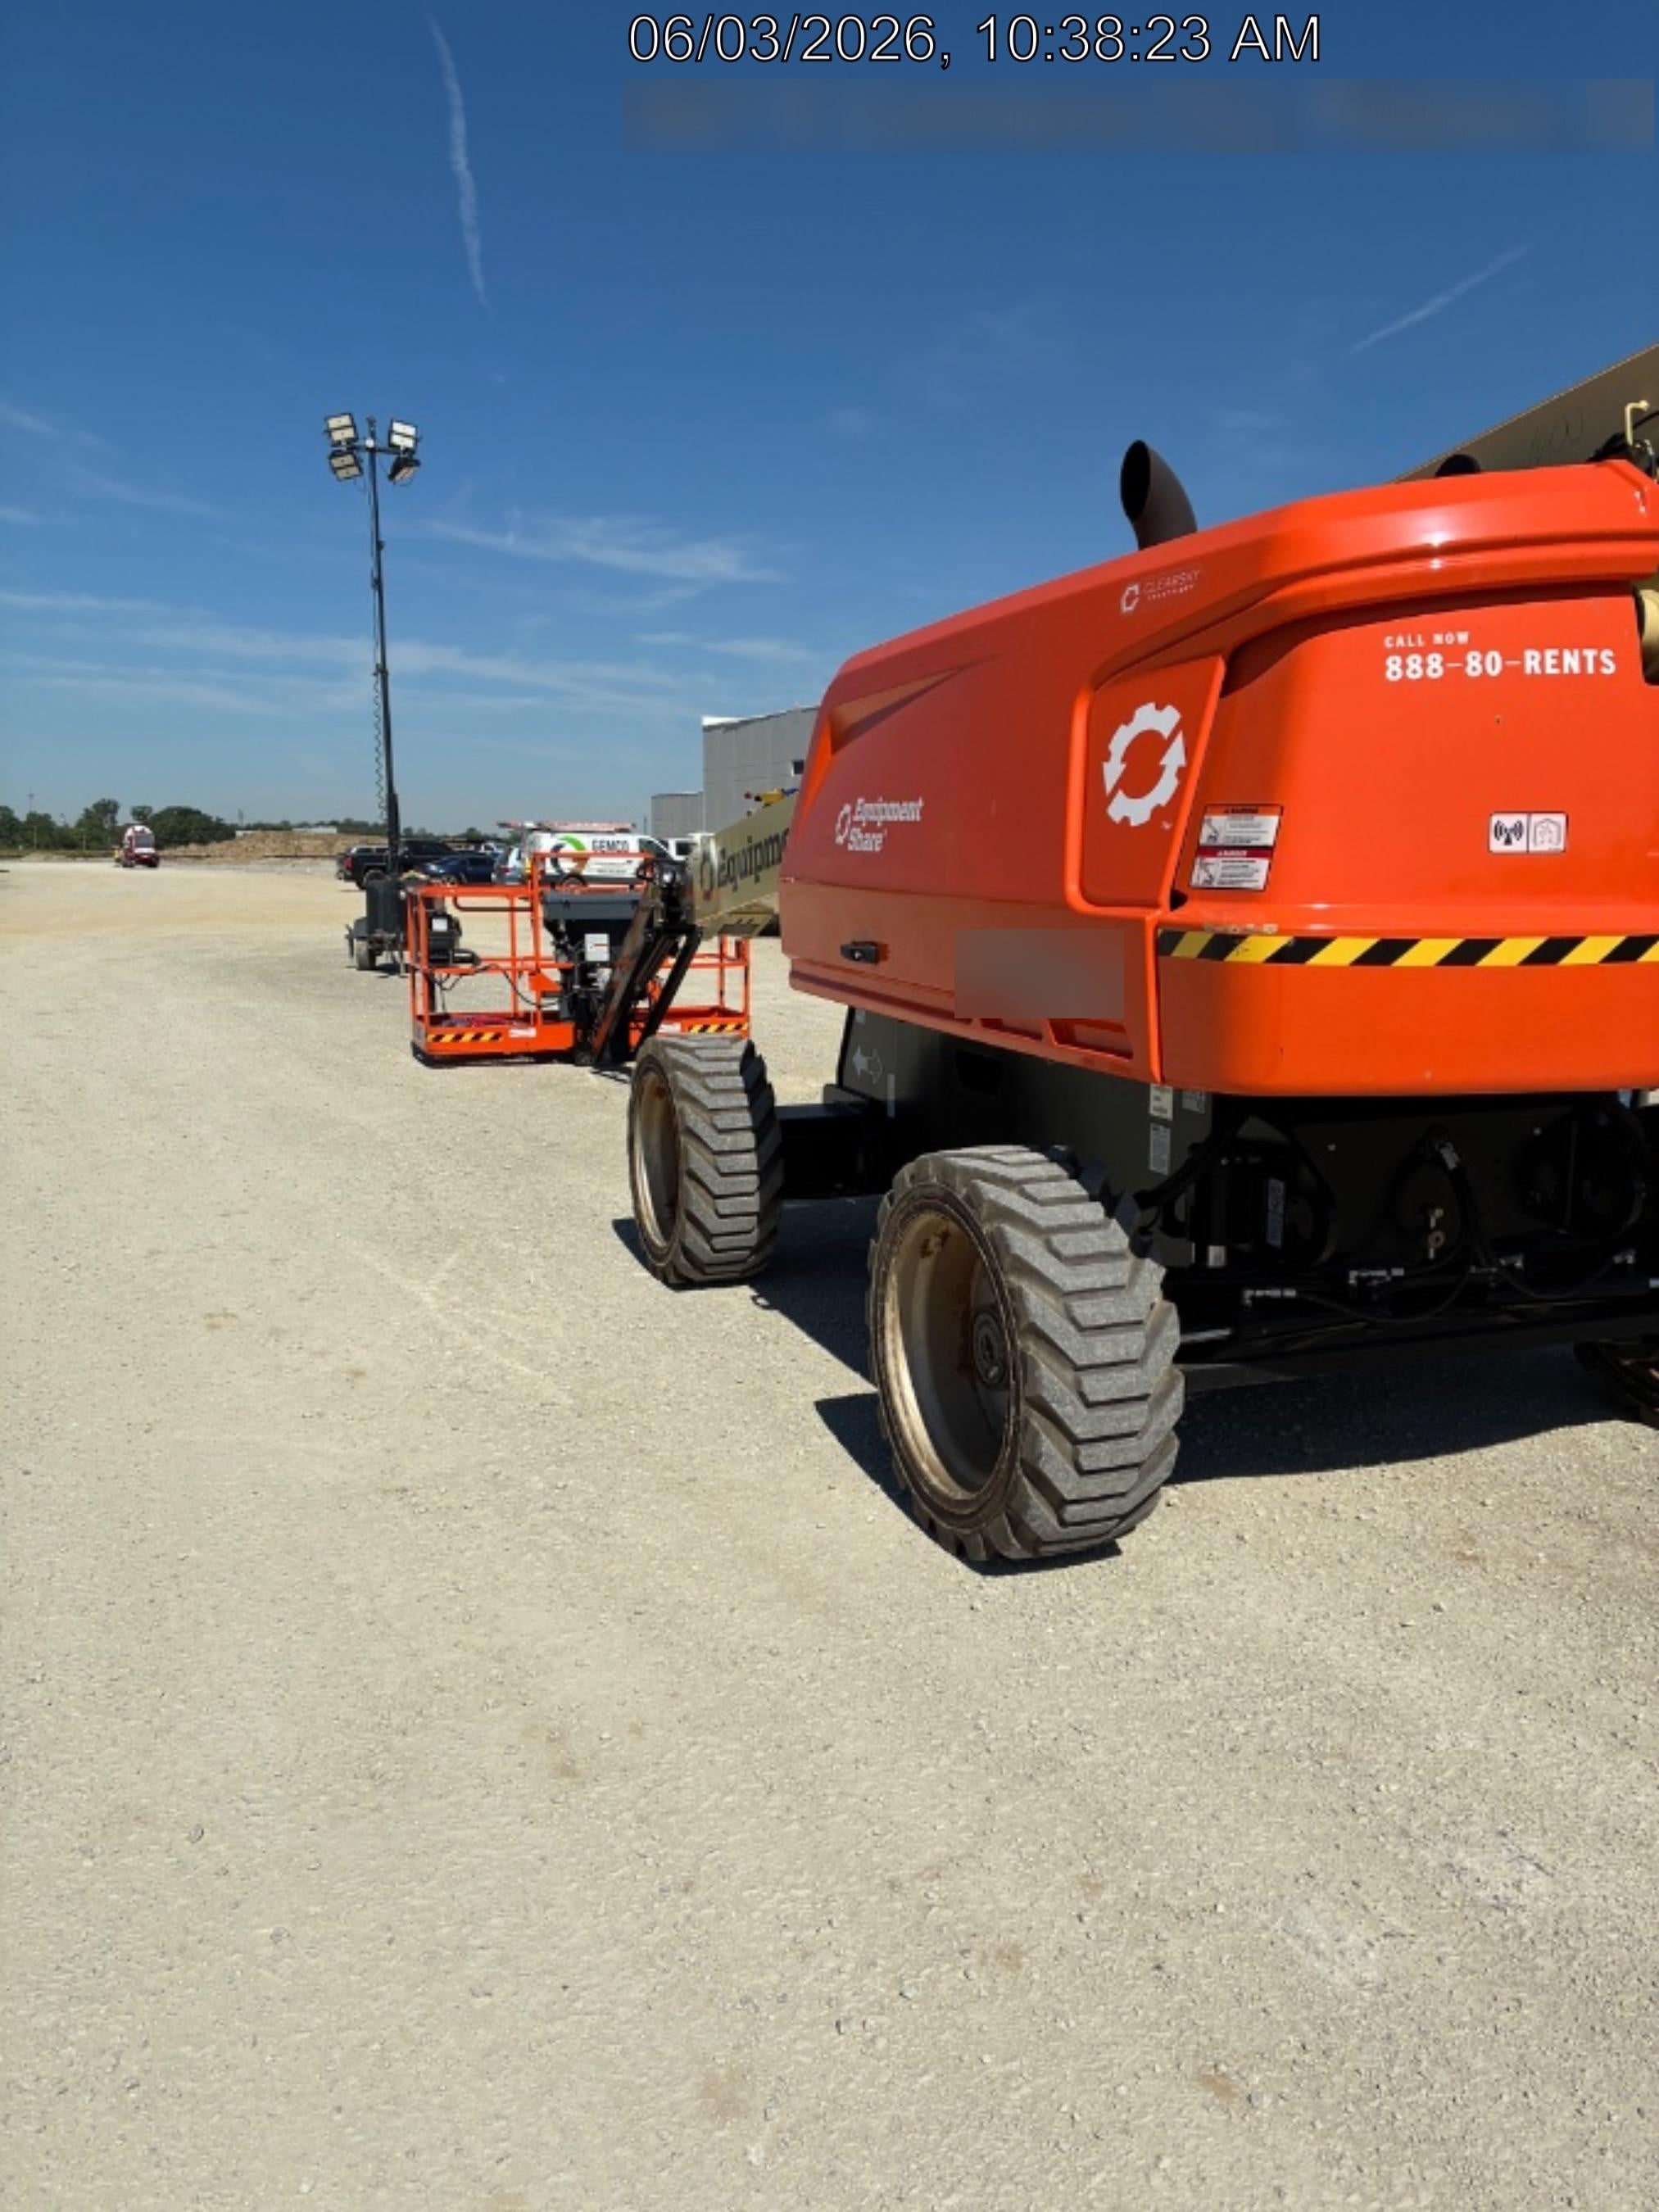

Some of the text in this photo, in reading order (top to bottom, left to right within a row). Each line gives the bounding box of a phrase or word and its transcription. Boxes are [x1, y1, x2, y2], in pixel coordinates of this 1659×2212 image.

[1384, 631, 1470, 648] CALL NOW
[1385, 648, 1616, 682] 888-80-RENTS
